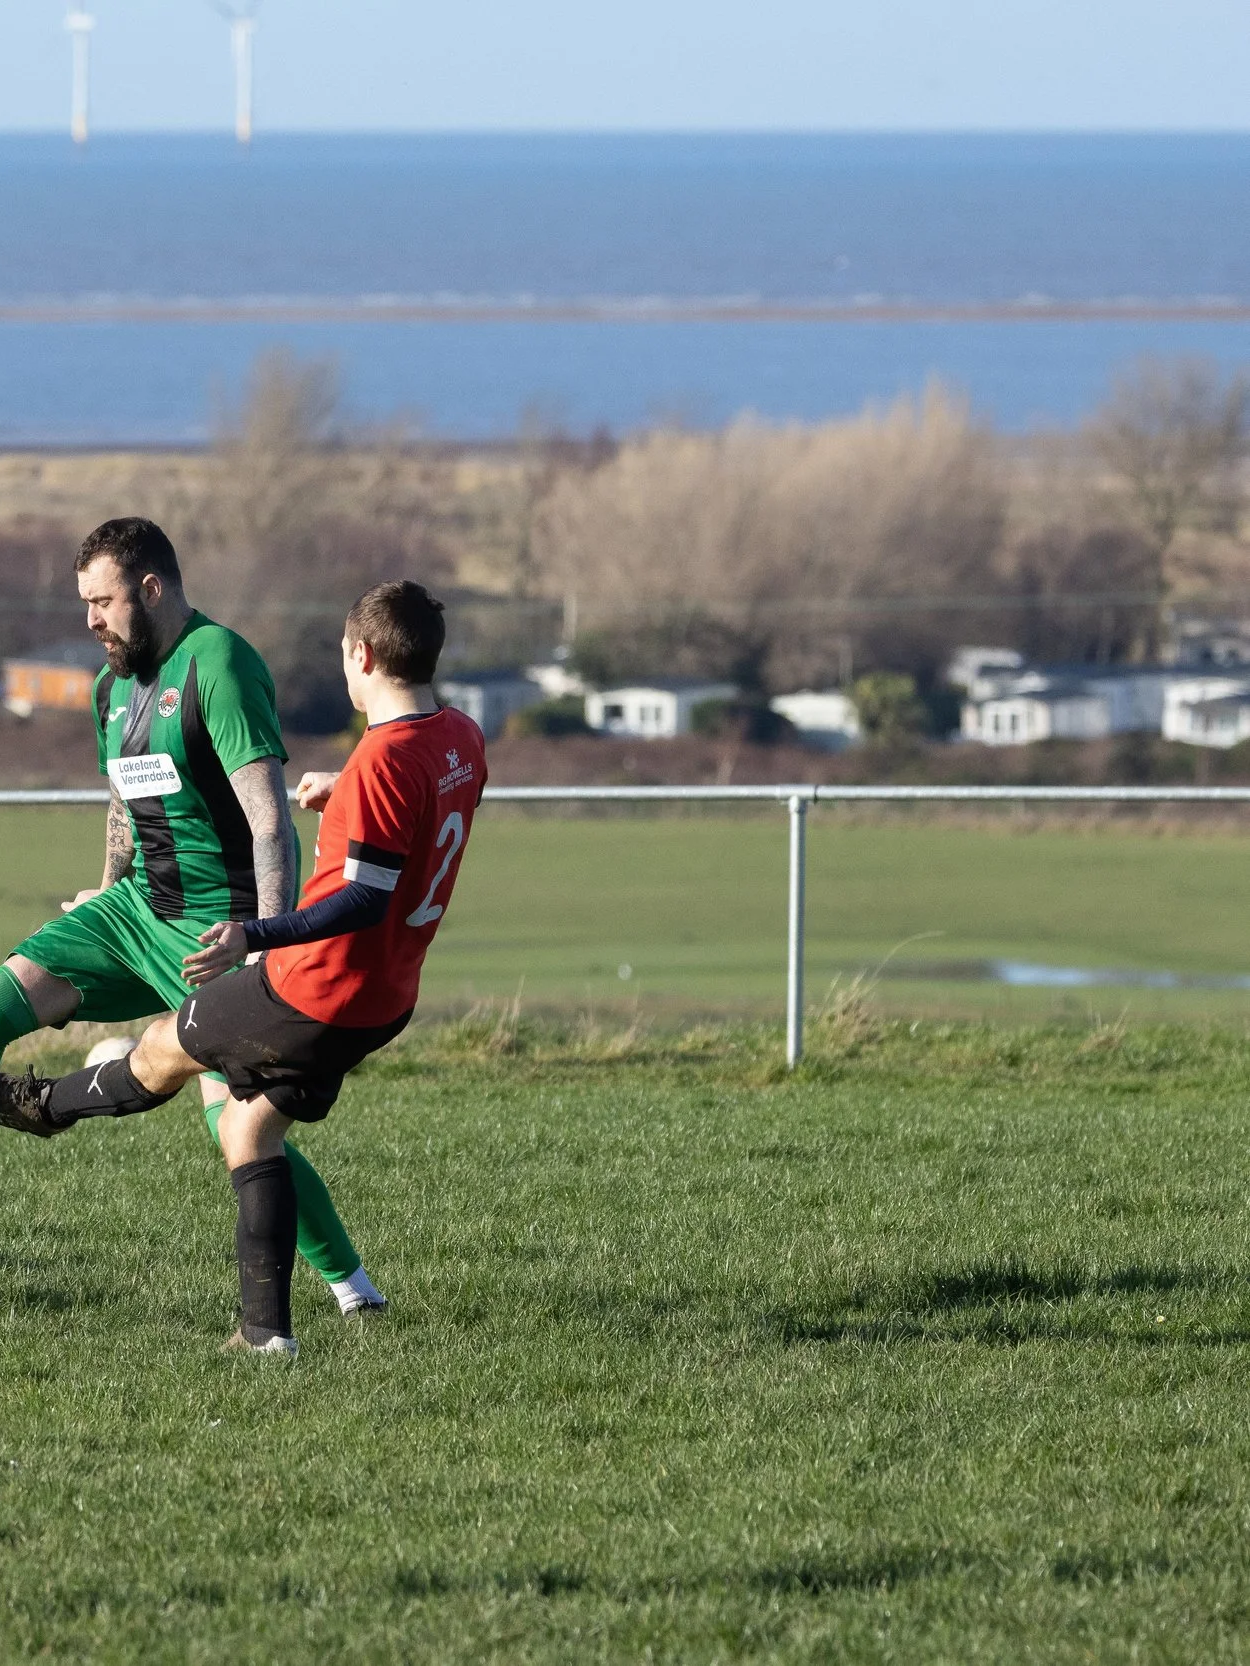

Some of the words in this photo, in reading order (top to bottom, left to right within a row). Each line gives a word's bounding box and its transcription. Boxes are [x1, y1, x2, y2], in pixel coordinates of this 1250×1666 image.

[118, 758, 161, 773] Lakeland
[121, 770, 176, 785] Verandahs
[438, 776, 447, 788] RG
[406, 811, 463, 927] 2
